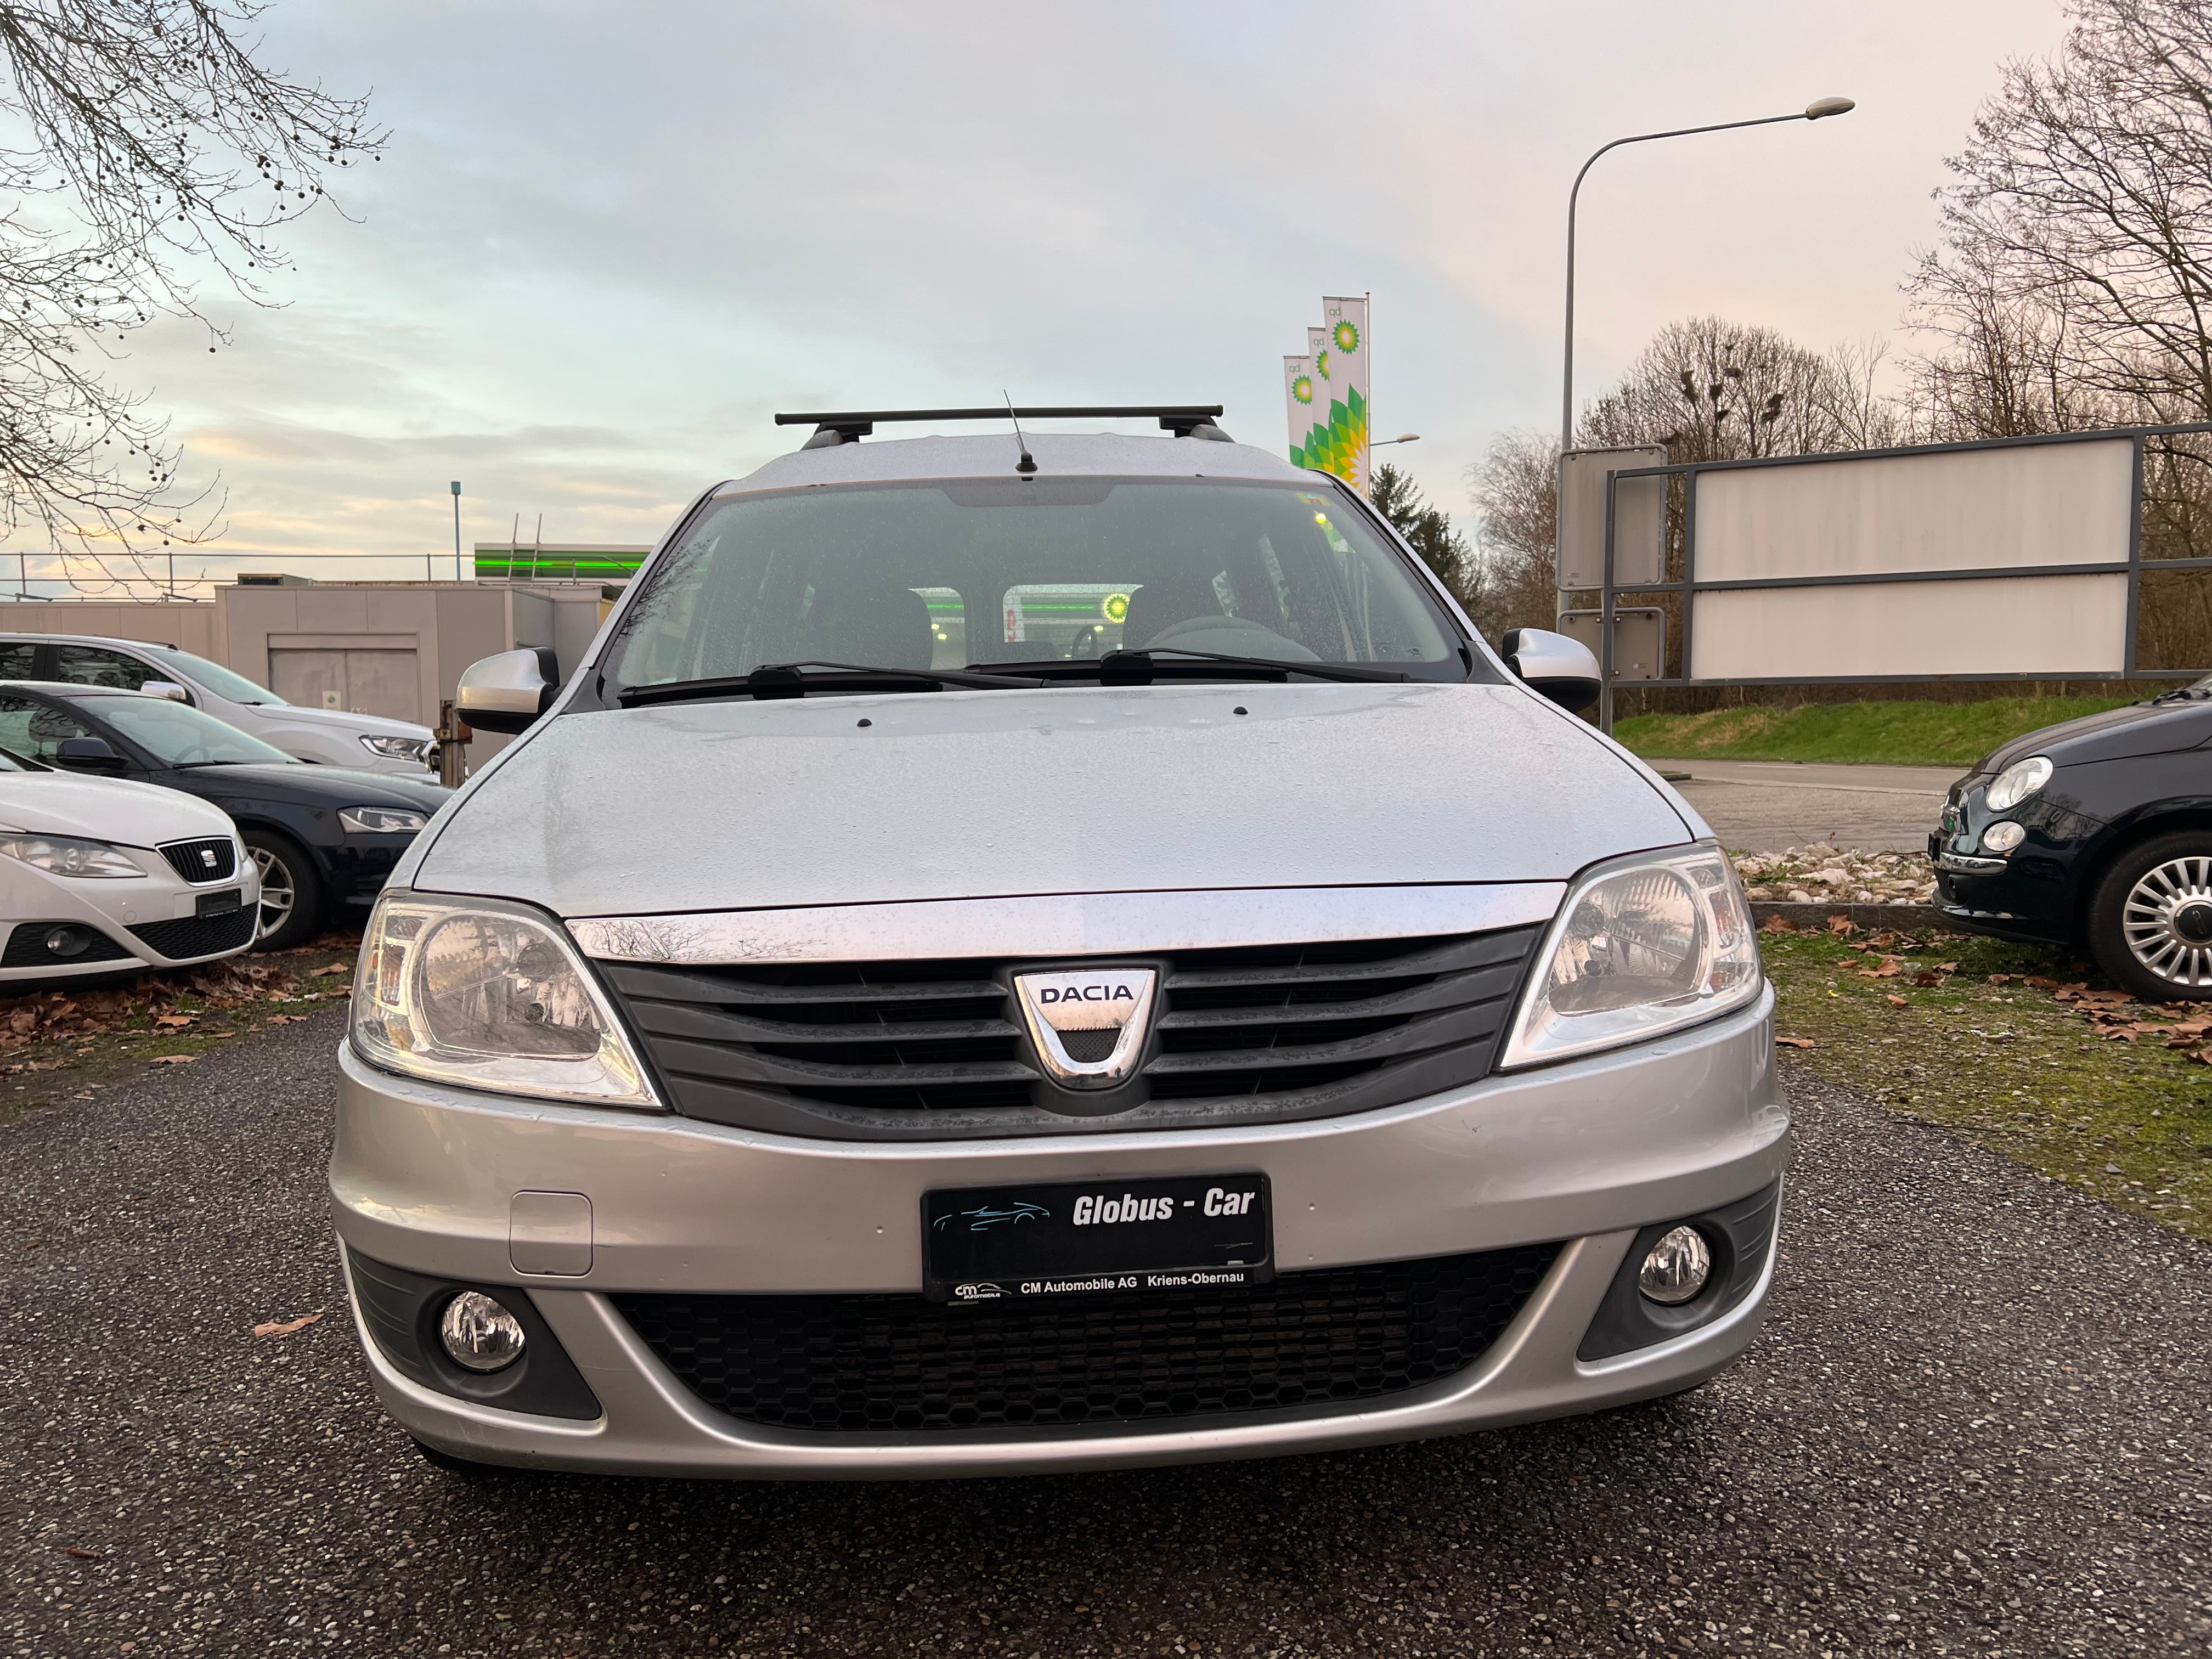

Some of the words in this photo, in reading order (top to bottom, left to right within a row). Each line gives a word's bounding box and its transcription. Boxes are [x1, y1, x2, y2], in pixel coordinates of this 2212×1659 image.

[1041, 985, 1134, 1004] DACIA
[1073, 1193, 1174, 1226] Globus
[1204, 1188, 1255, 1216] Car
[1021, 1282, 1041, 1294] CM
[1043, 1278, 1115, 1293] Automobile
[1118, 1276, 1137, 1288] AG
[1148, 1273, 1244, 1286] Kriens-Obernau
